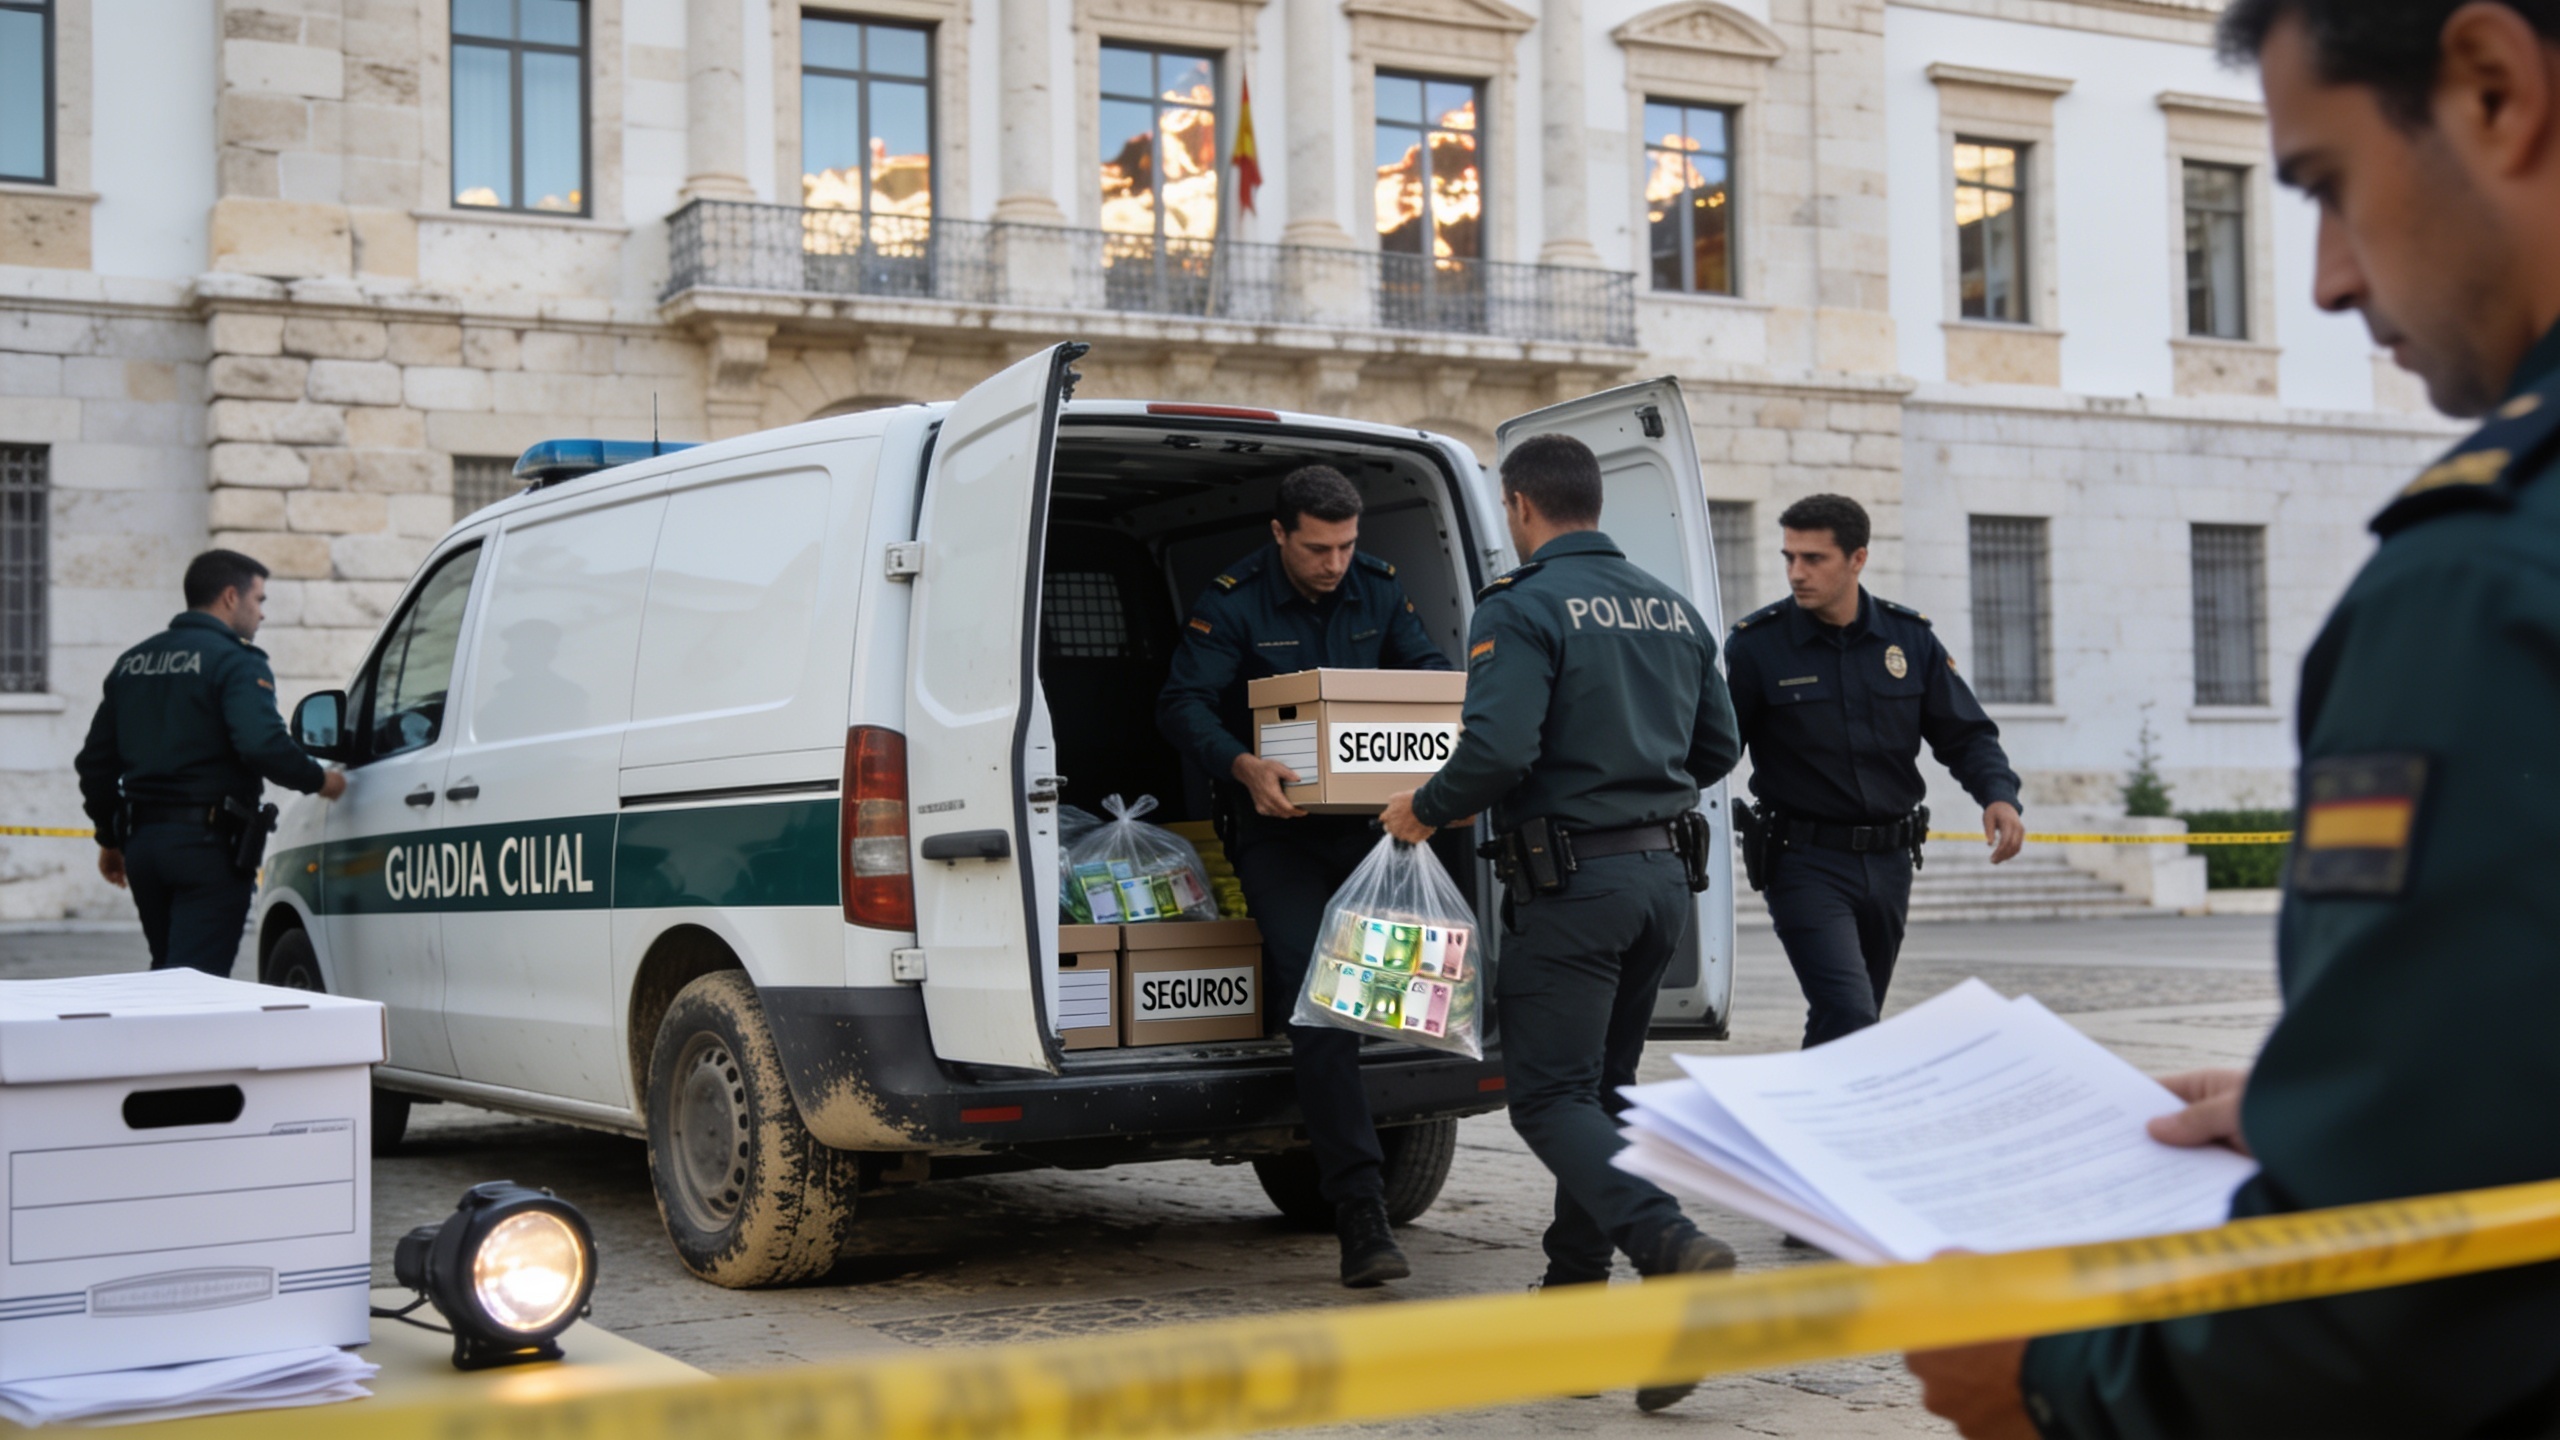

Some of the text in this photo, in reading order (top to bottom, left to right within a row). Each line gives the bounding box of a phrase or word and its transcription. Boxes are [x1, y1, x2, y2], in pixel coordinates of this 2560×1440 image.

[1338, 731, 1450, 763] SEGUROS
[385, 833, 594, 901] GUADIA CILIAL
[1142, 975, 1248, 1011] SEGUROS
